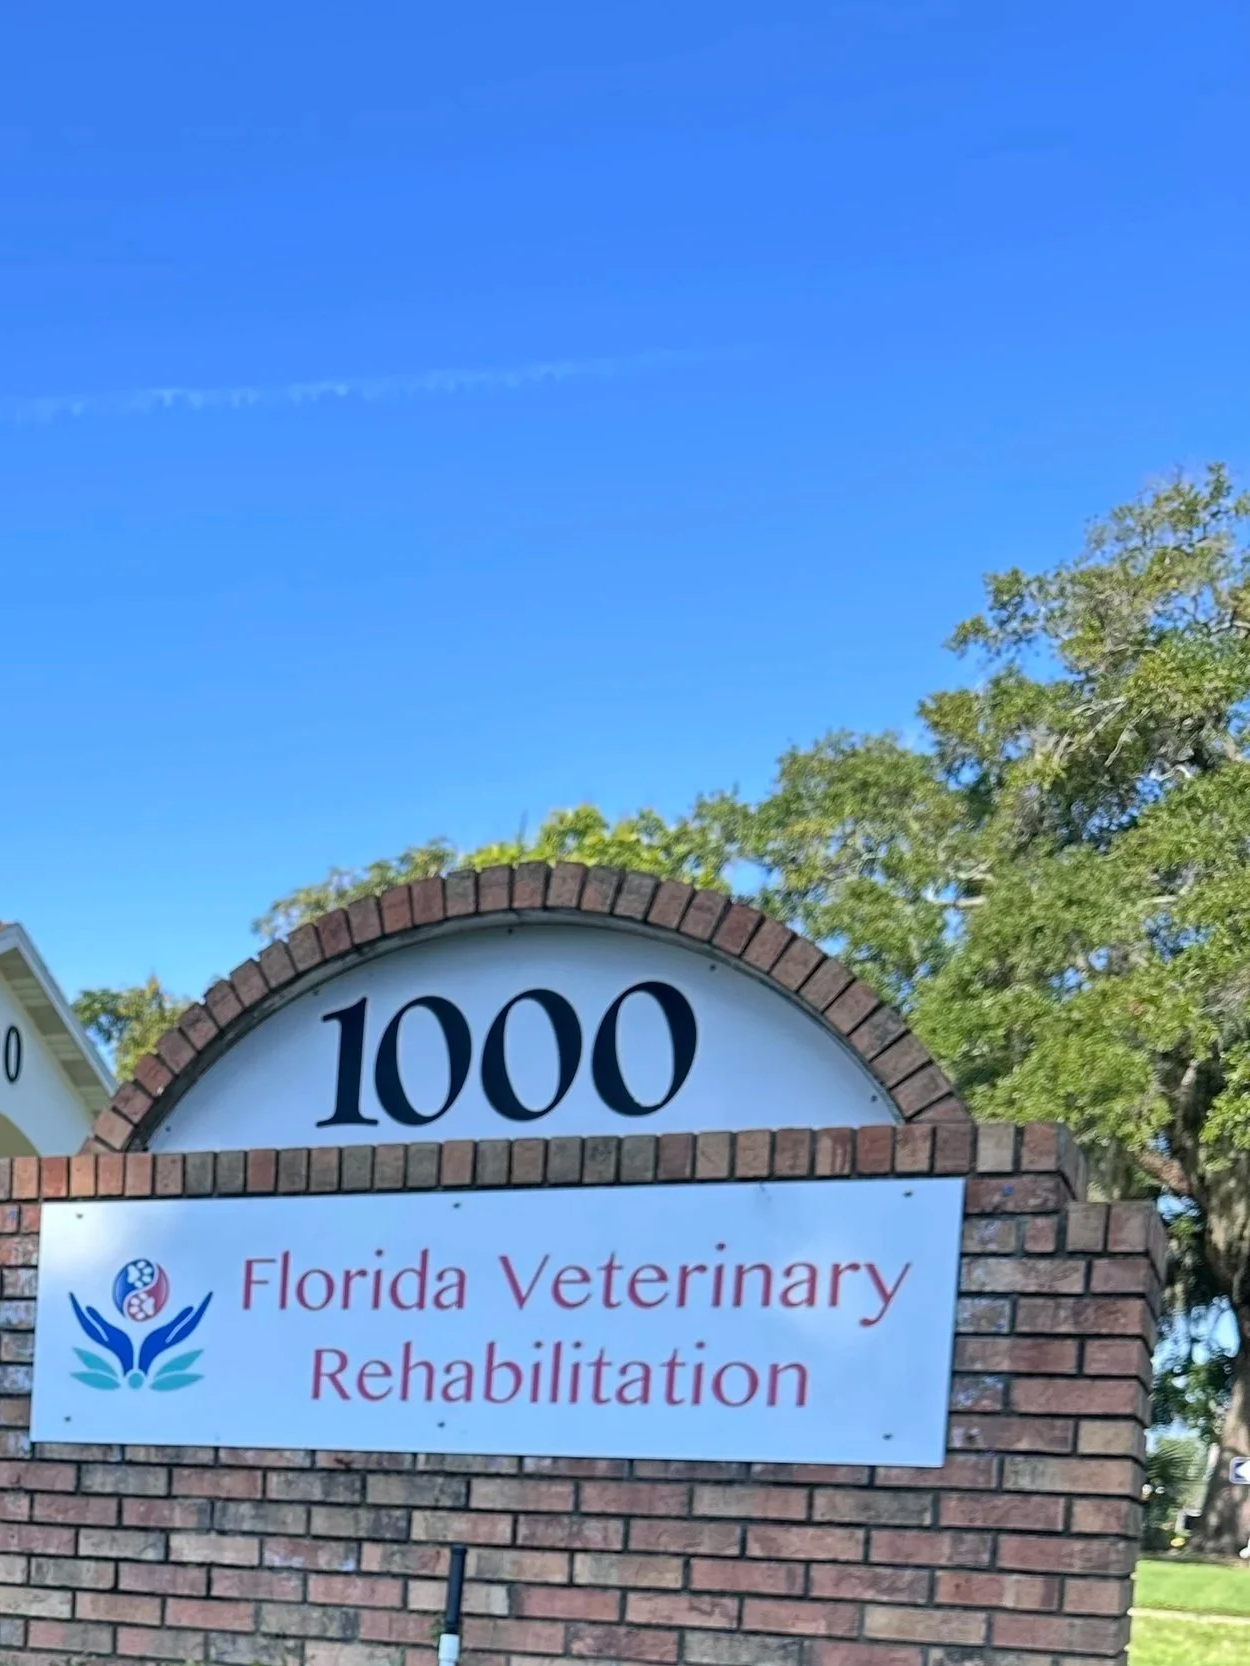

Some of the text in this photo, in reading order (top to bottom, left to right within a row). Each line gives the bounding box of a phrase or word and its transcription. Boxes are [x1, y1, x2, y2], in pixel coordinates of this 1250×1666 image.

[315, 980, 698, 1128] 1000
[241, 1242, 911, 1326] Florida Veterinary
[311, 1341, 809, 1408] Rehabilitation
